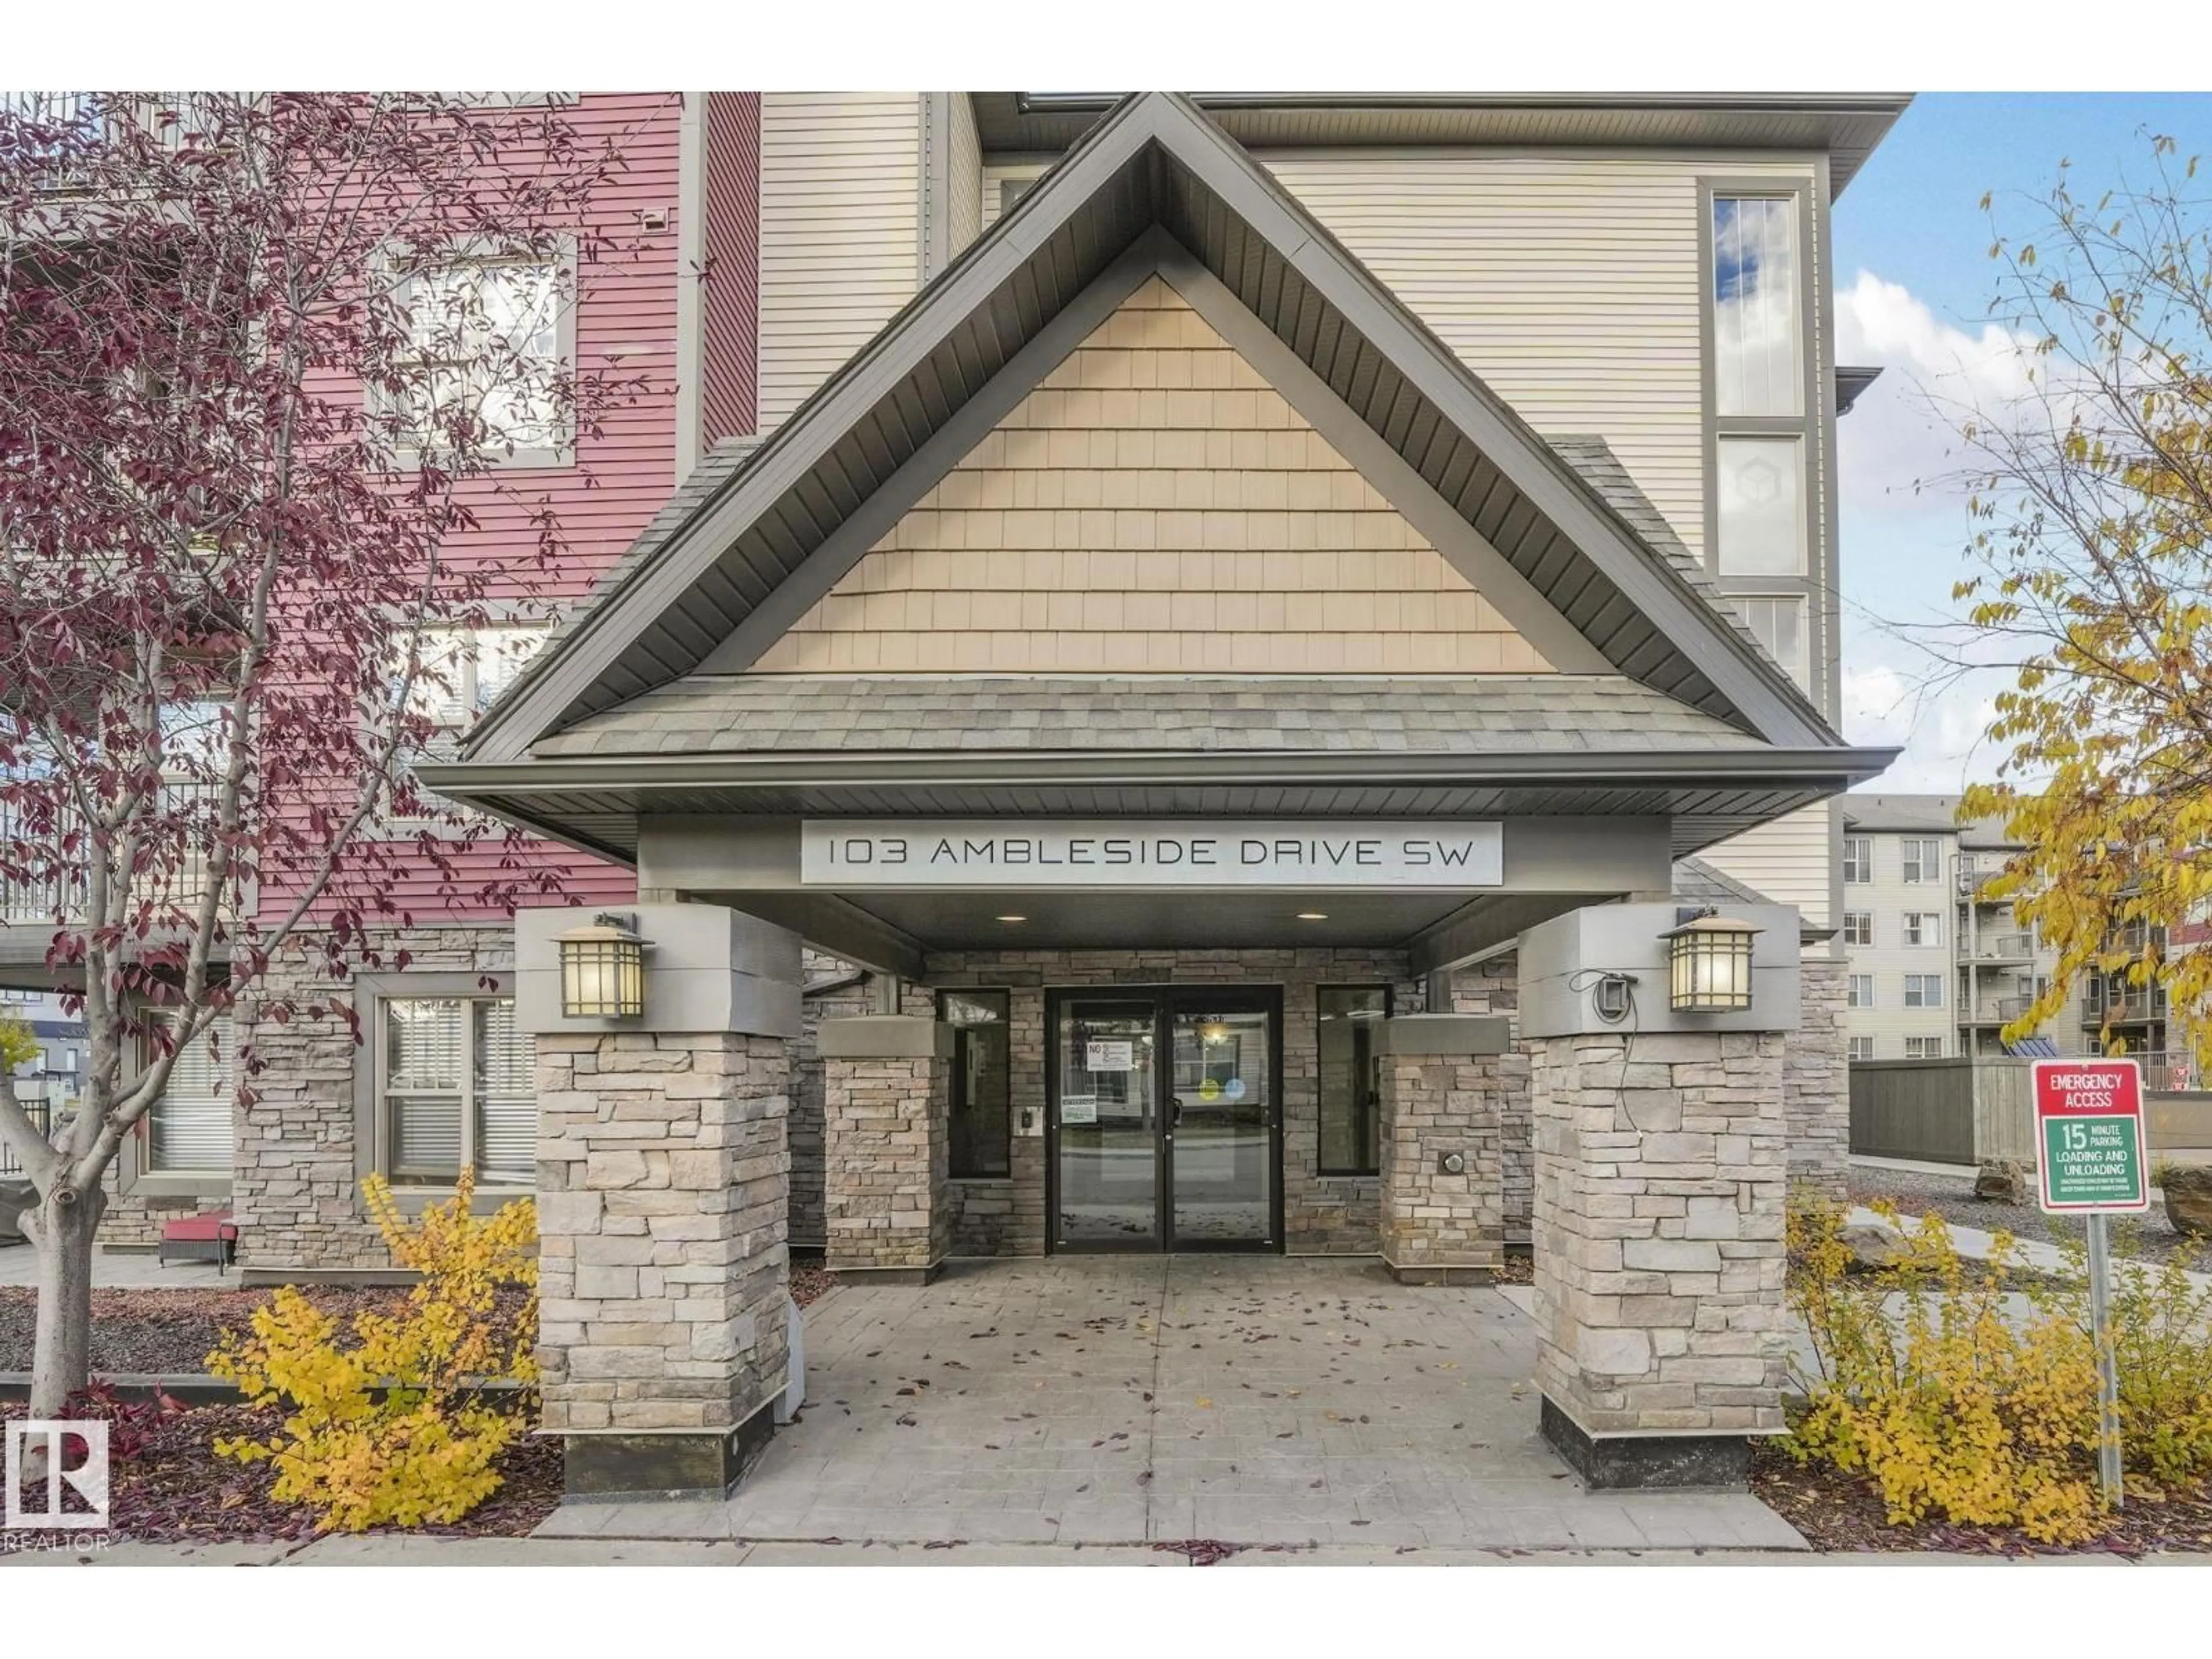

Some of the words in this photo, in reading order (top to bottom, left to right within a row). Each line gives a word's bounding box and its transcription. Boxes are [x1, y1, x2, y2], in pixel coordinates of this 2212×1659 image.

[830, 839, 907, 863] 103
[930, 839, 1217, 865] AMBLESIDE
[1241, 840, 1382, 865] DRIVE
[1403, 840, 1473, 866] SW
[1089, 1044, 1101, 1054] NO
[2050, 1074, 2123, 1090] EMERGENCY
[2066, 1092, 2112, 1107] ACCESS
[2091, 1125, 2121, 1135] MINUTE
[2062, 1124, 2087, 1150] 15
[2090, 1137, 2123, 1147] PARKING
[2055, 1151, 2102, 1162] LOADING
[2105, 1150, 2127, 1161] AND
[2064, 1164, 2124, 1176] UNLOADING
